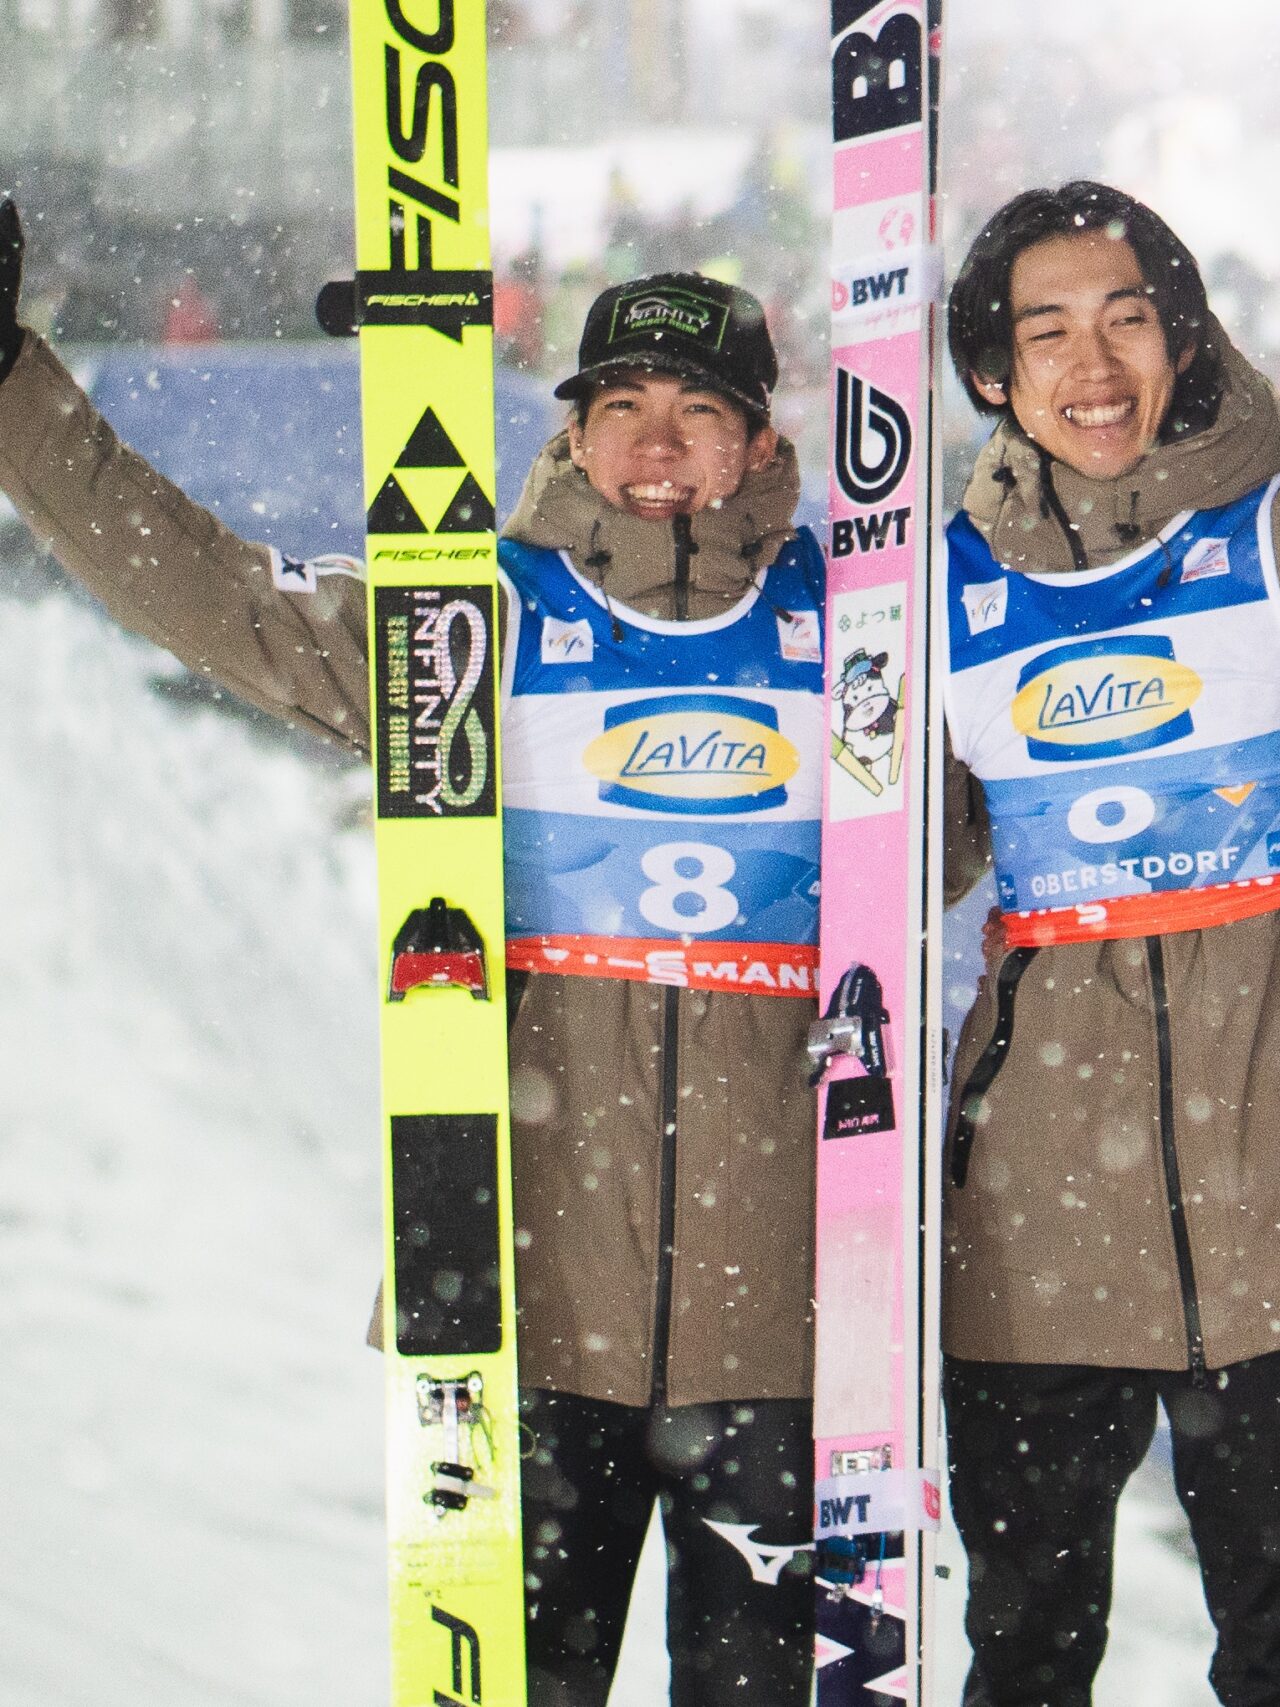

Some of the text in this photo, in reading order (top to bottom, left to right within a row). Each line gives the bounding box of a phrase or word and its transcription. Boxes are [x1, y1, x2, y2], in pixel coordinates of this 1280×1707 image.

[367, 294, 467, 306] FISCHER
[853, 267, 908, 306] BWT
[374, 548, 491, 561] FISCHER
[832, 507, 911, 558] BWT
[414, 591, 443, 815] INFINITY
[639, 841, 739, 933] 8
[1031, 846, 1240, 897] OBERSTDORF
[820, 1494, 871, 1529] BWT
